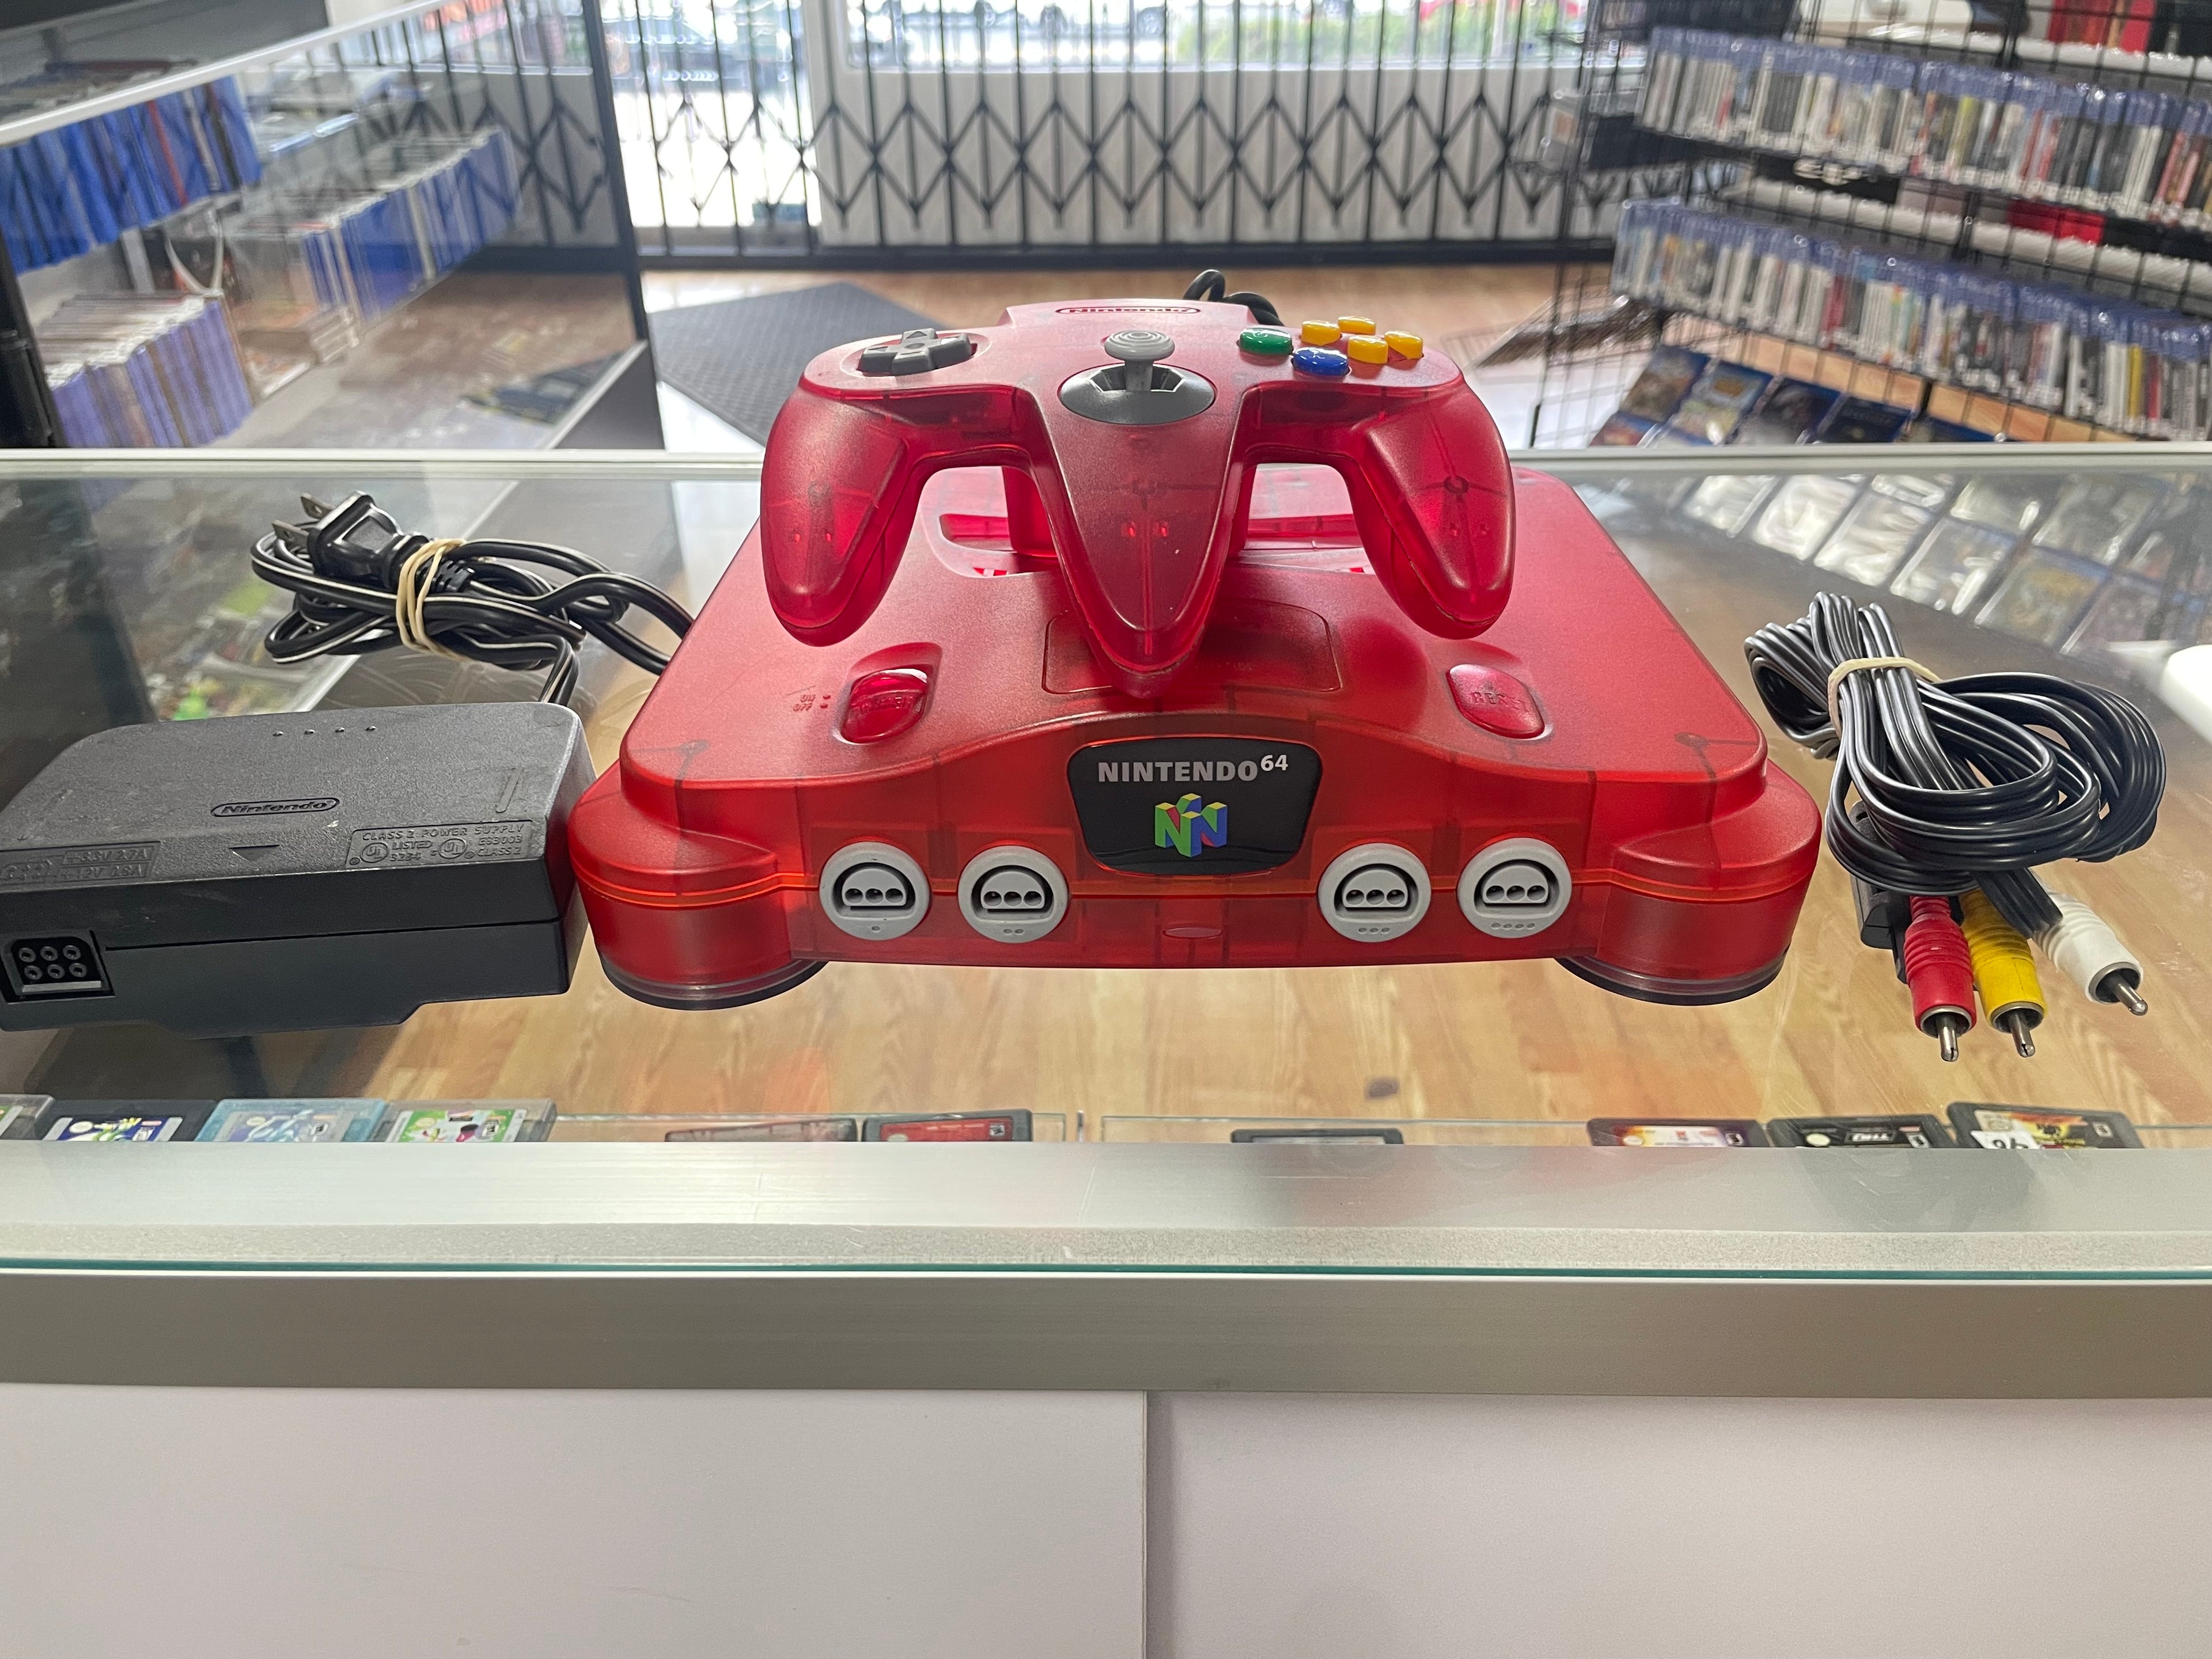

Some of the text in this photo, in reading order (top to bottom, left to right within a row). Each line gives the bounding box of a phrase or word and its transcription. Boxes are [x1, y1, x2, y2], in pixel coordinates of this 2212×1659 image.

[800, 694, 816, 703] ON
[793, 702, 813, 711] OFF
[1098, 755, 1289, 782] NINTENDO 64
[221, 801, 328, 815] Nintendo
[362, 824, 525, 841] CLASS 2 POWER SUPPLY
[392, 839, 433, 850] LISTED
[477, 847, 521, 857] CLASS 2
